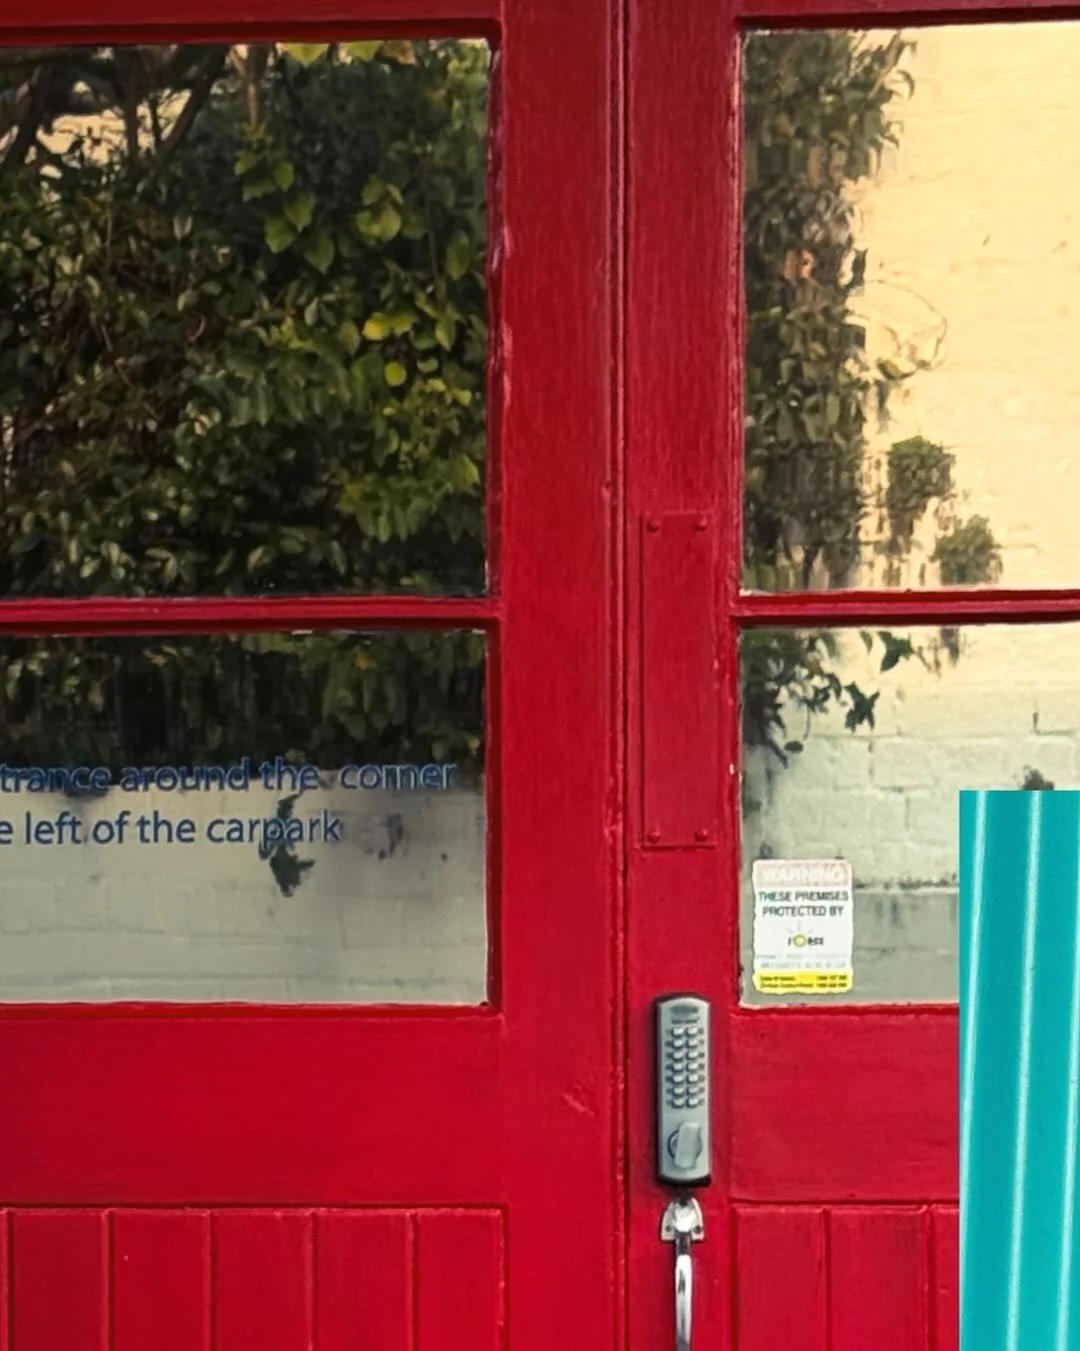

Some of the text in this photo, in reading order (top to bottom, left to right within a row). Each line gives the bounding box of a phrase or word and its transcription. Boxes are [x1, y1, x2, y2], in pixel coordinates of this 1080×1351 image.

[121, 758, 250, 792] around
[259, 756, 319, 791] the
[339, 764, 456, 790] corner
[24, 810, 83, 844] left
[91, 811, 131, 844] of
[136, 810, 196, 843] the
[205, 810, 342, 849] carpark
[762, 905, 845, 917] PROTECTED BY
